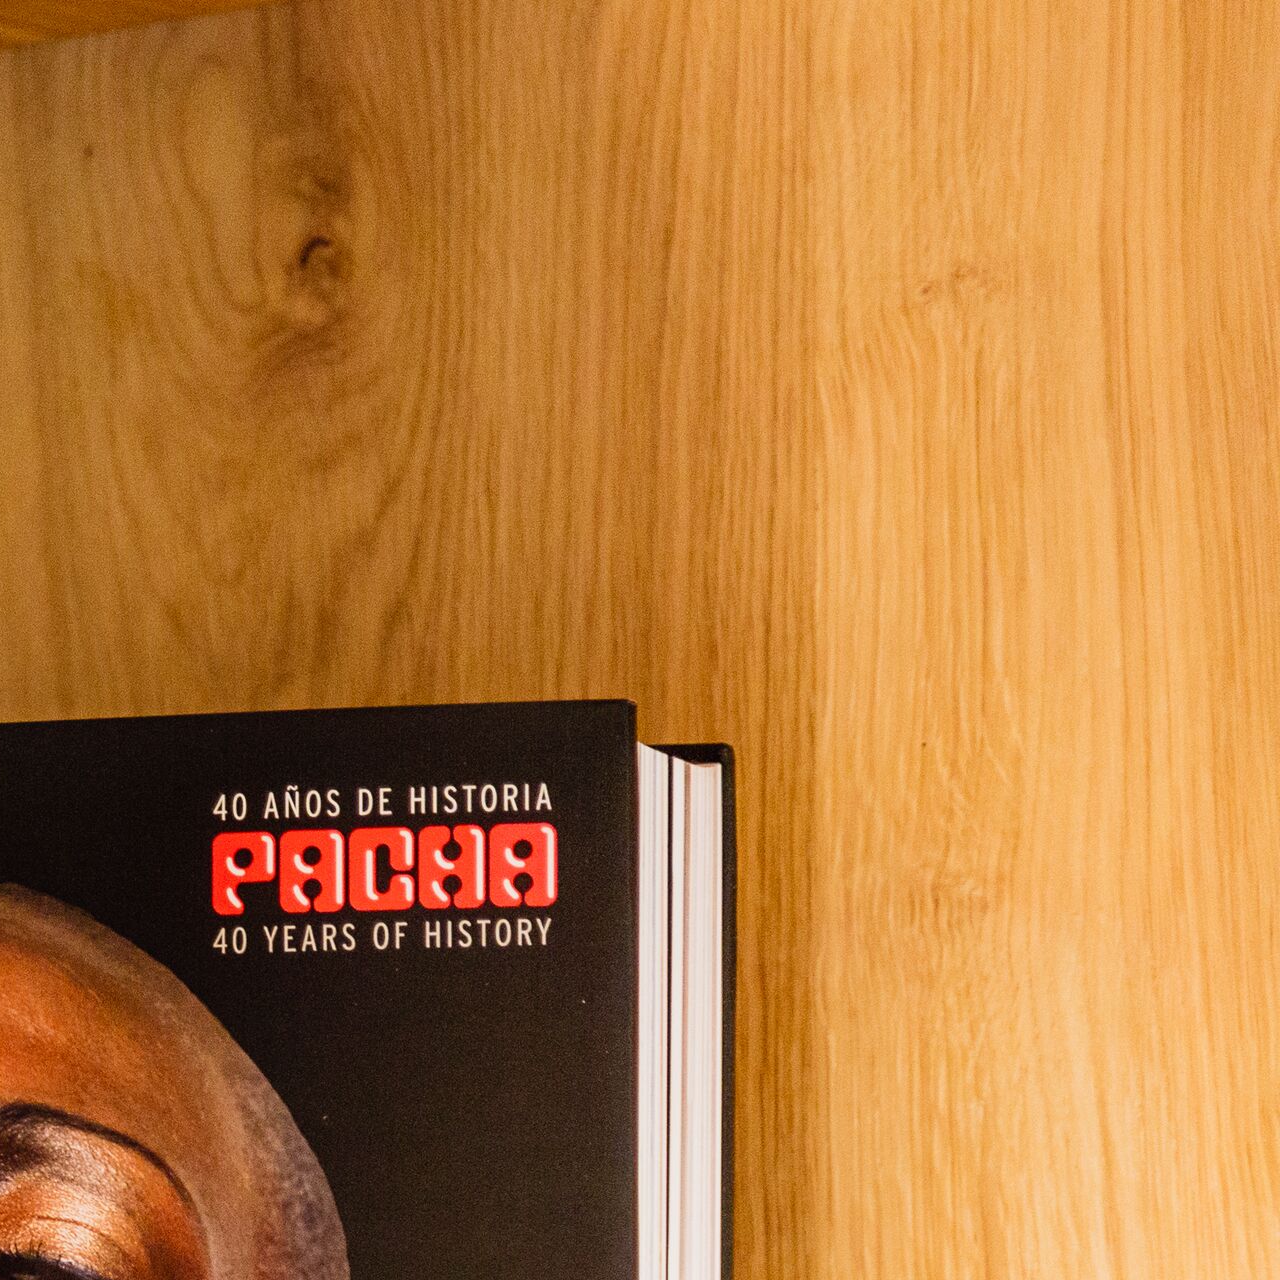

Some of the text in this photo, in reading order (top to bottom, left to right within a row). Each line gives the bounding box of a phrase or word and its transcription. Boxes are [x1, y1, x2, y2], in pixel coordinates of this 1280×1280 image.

[212, 782, 553, 821] 40 AÑOS DE HISTORIA
[211, 821, 559, 916] PACHA
[212, 917, 553, 955] 40 YEARS OF HISTORY
